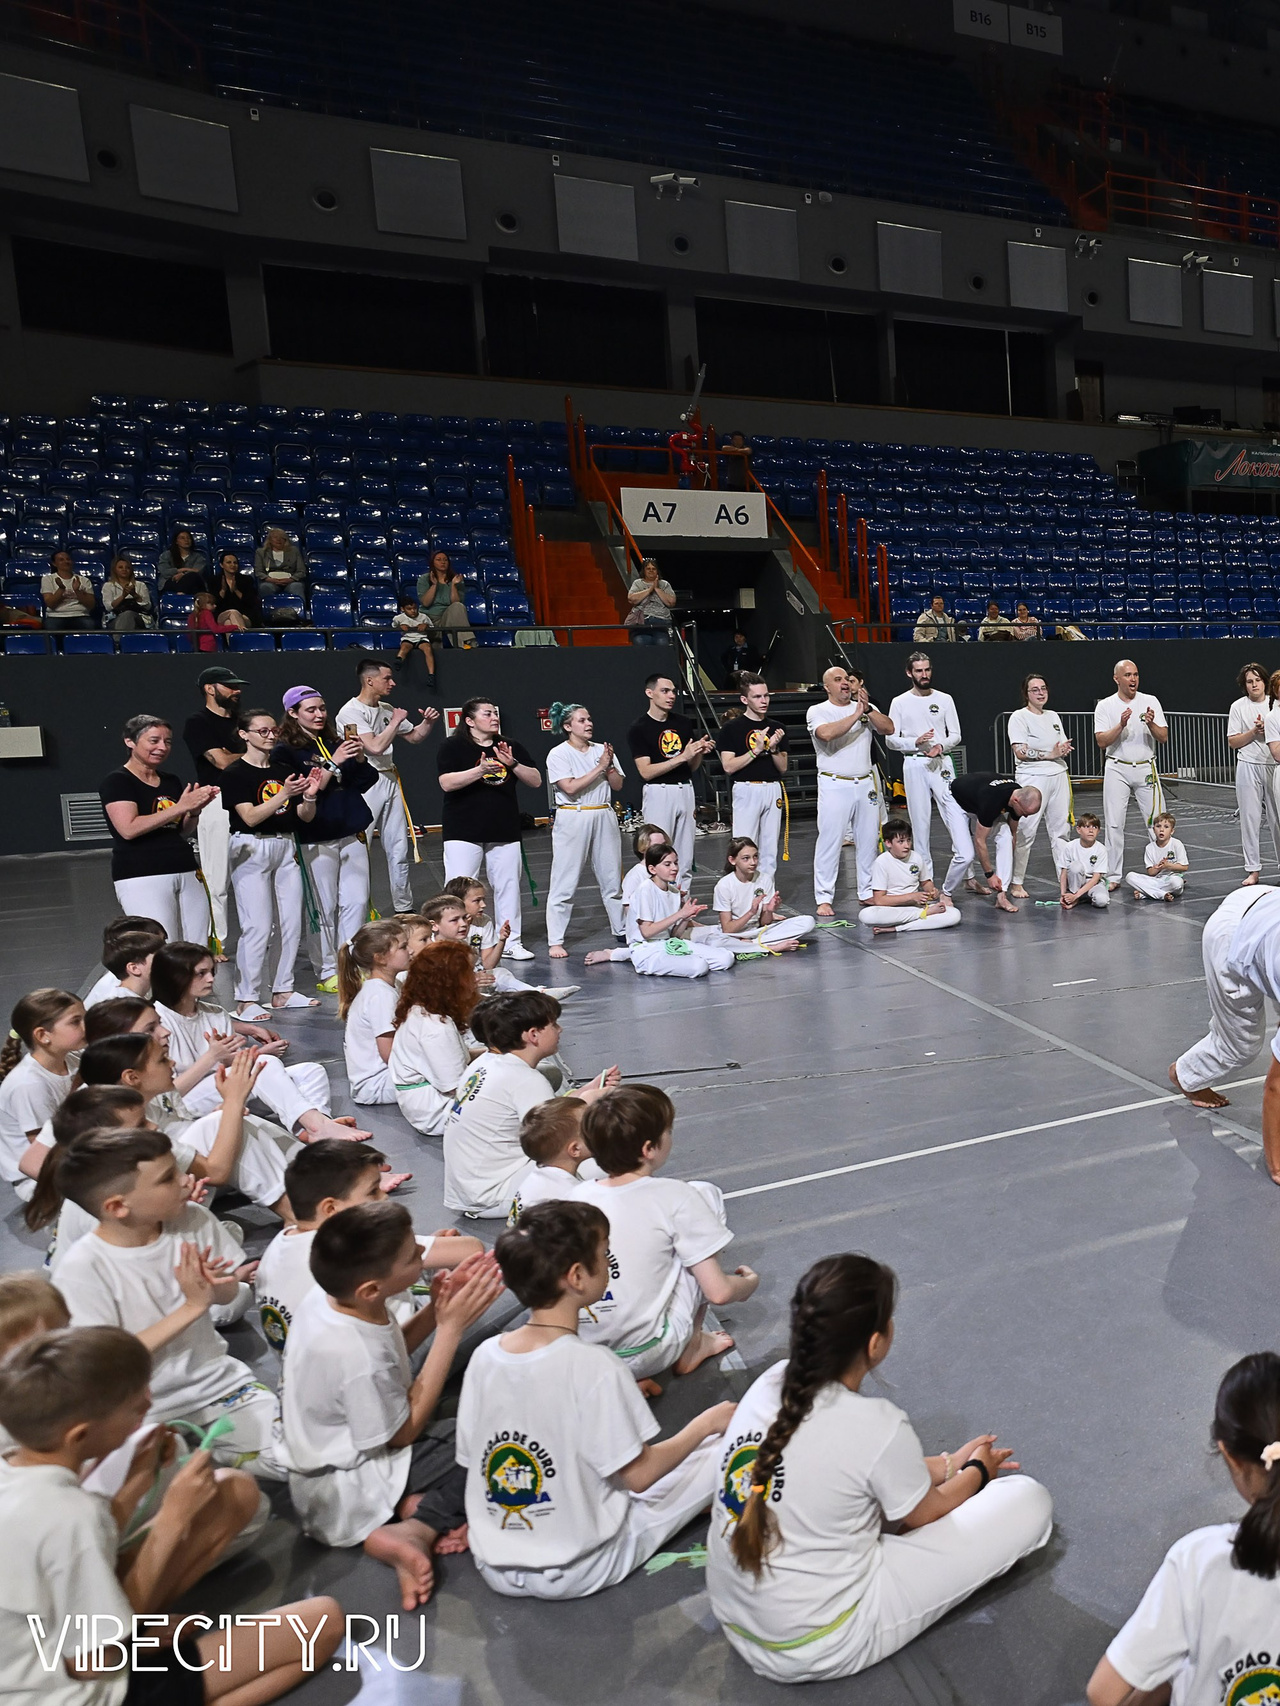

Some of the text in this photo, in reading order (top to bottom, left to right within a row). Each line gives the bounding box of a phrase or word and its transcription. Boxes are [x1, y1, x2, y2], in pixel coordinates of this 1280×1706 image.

[970, 10, 992, 26] B16
[1026, 23, 1047, 38] B15
[642, 501, 677, 524] A7
[714, 504, 750, 526] A6
[512, 1430, 528, 1445] DE
[529, 1440, 556, 1479] OURO
